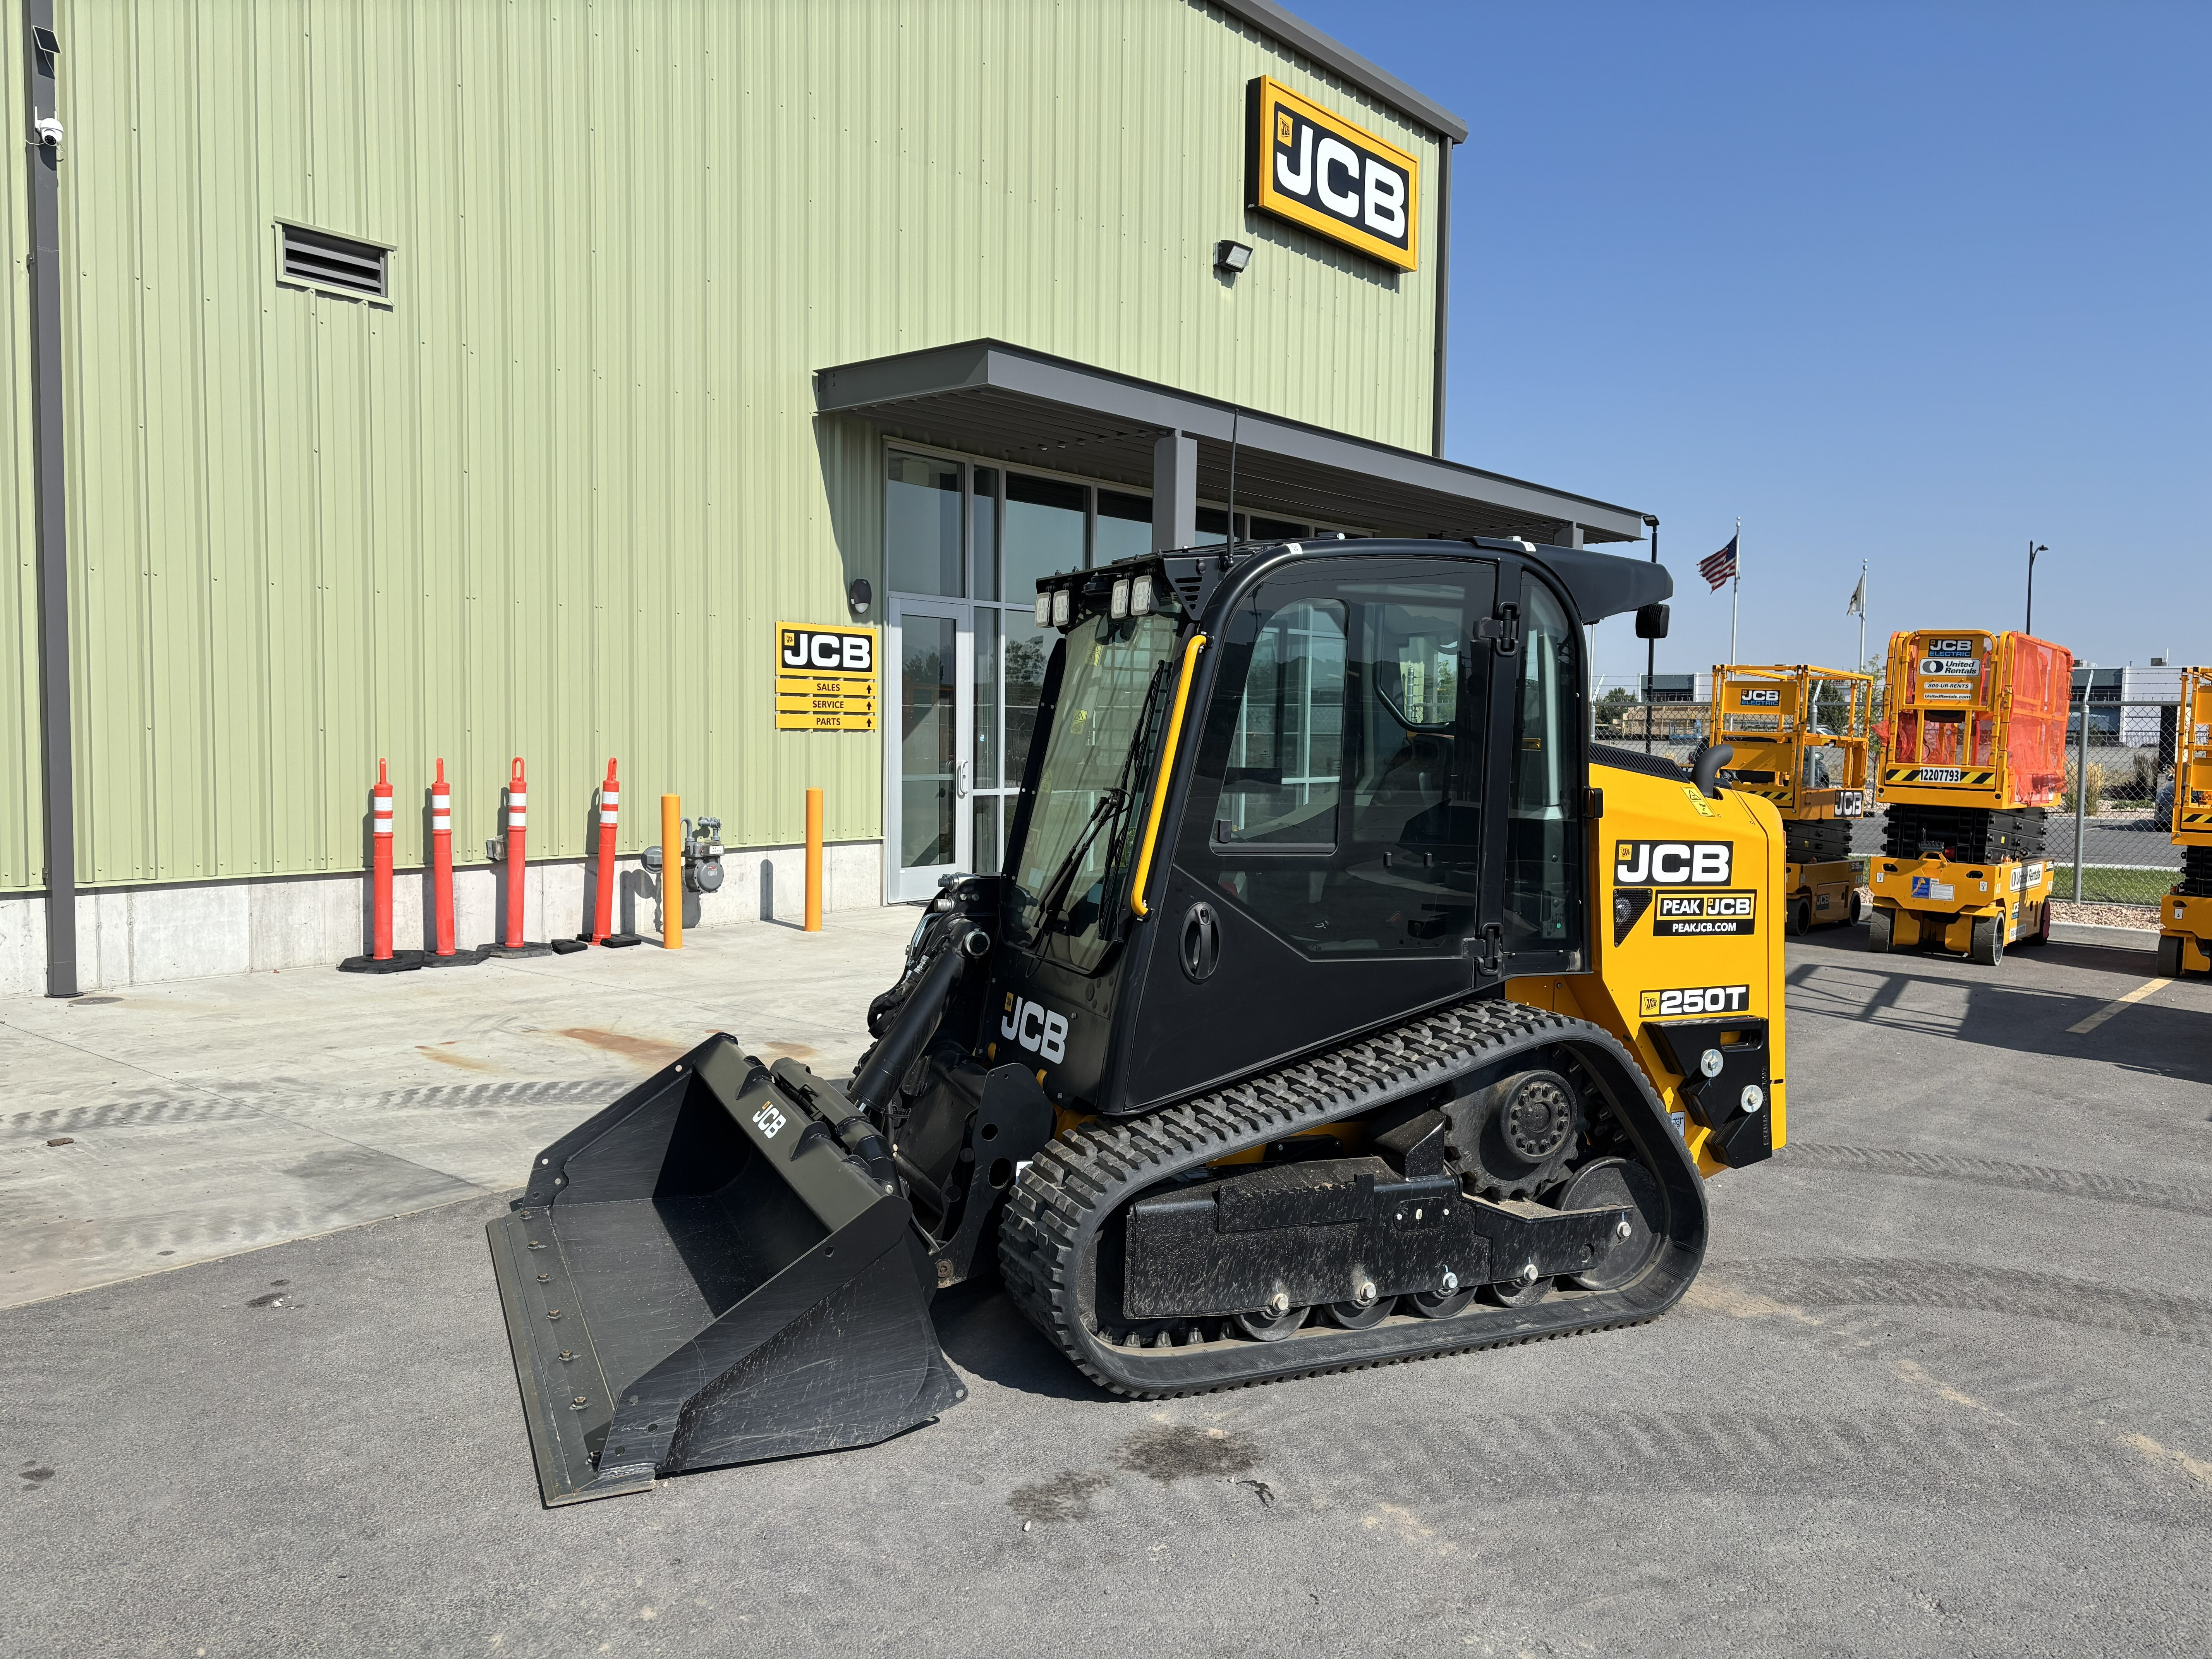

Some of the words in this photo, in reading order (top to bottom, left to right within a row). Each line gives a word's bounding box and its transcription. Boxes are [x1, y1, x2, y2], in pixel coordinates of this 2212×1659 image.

[1277, 124, 1406, 238] JCB
[784, 634, 870, 668] JCB
[1930, 640, 1972, 651] JCB
[817, 683, 840, 692] SALES
[1742, 690, 1779, 701] JCB
[812, 700, 844, 709] SERVICE
[816, 717, 841, 726] PARTS
[1920, 768, 1959, 782] 12207793
[1835, 792, 1862, 815] JCB
[1617, 844, 1730, 883] JCB
[1663, 900, 1700, 914] PEAK
[1707, 898, 1750, 914] JCB
[1817, 894, 1829, 905] JCB
[1673, 922, 1736, 932] PEAKJCB.COM
[1661, 986, 1746, 1014] 250T
[1001, 996, 1068, 1064] JCB
[752, 1104, 787, 1139] JCB
